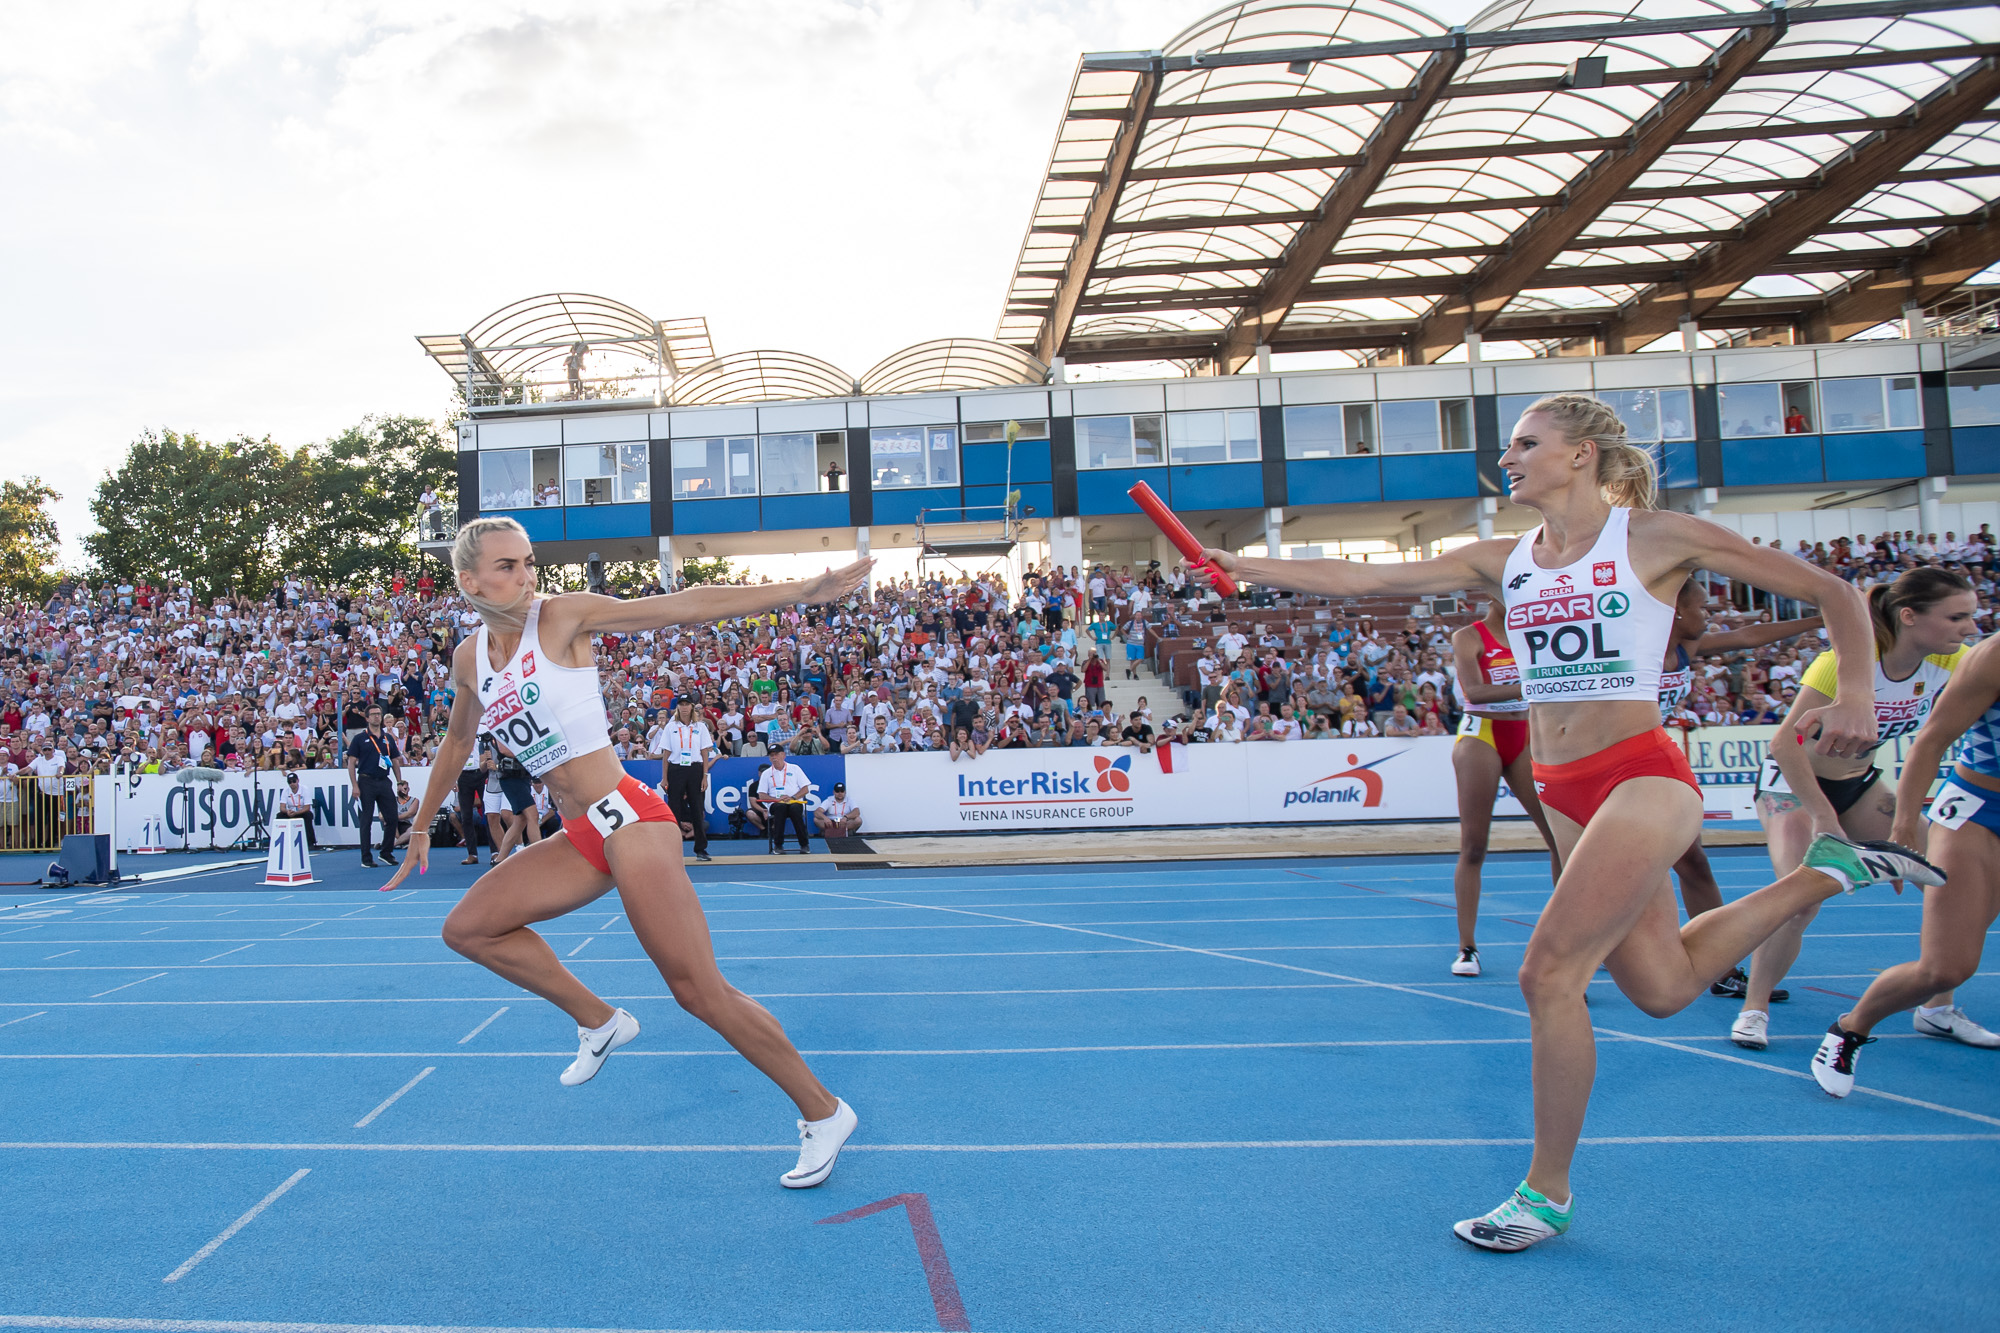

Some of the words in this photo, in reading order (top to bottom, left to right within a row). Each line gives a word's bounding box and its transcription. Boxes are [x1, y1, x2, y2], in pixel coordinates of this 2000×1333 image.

[1541, 586, 1573, 597] ORLEN
[1509, 597, 1592, 627] SPAR
[1524, 622, 1620, 665] POL
[1493, 668, 1520, 680] SPA
[1541, 666, 1562, 677] RUN
[1525, 679, 1597, 695] BYDGOSZCZ
[1600, 676, 1635, 689] 2019
[1875, 706, 1917, 720] PAR
[495, 711, 550, 747] POL
[1464, 715, 1474, 731] 2
[549, 744, 568, 760] 2019
[66, 780, 75, 789] 23
[958, 770, 1091, 797] InterRisk
[1768, 765, 1782, 787] 7
[1283, 786, 1362, 808] polanik
[596, 799, 624, 831] 5
[960, 810, 1008, 821] VIENNA
[1011, 808, 1086, 820] INSURANCE
[1089, 806, 1134, 818] GROUP
[1938, 796, 1966, 820] 6
